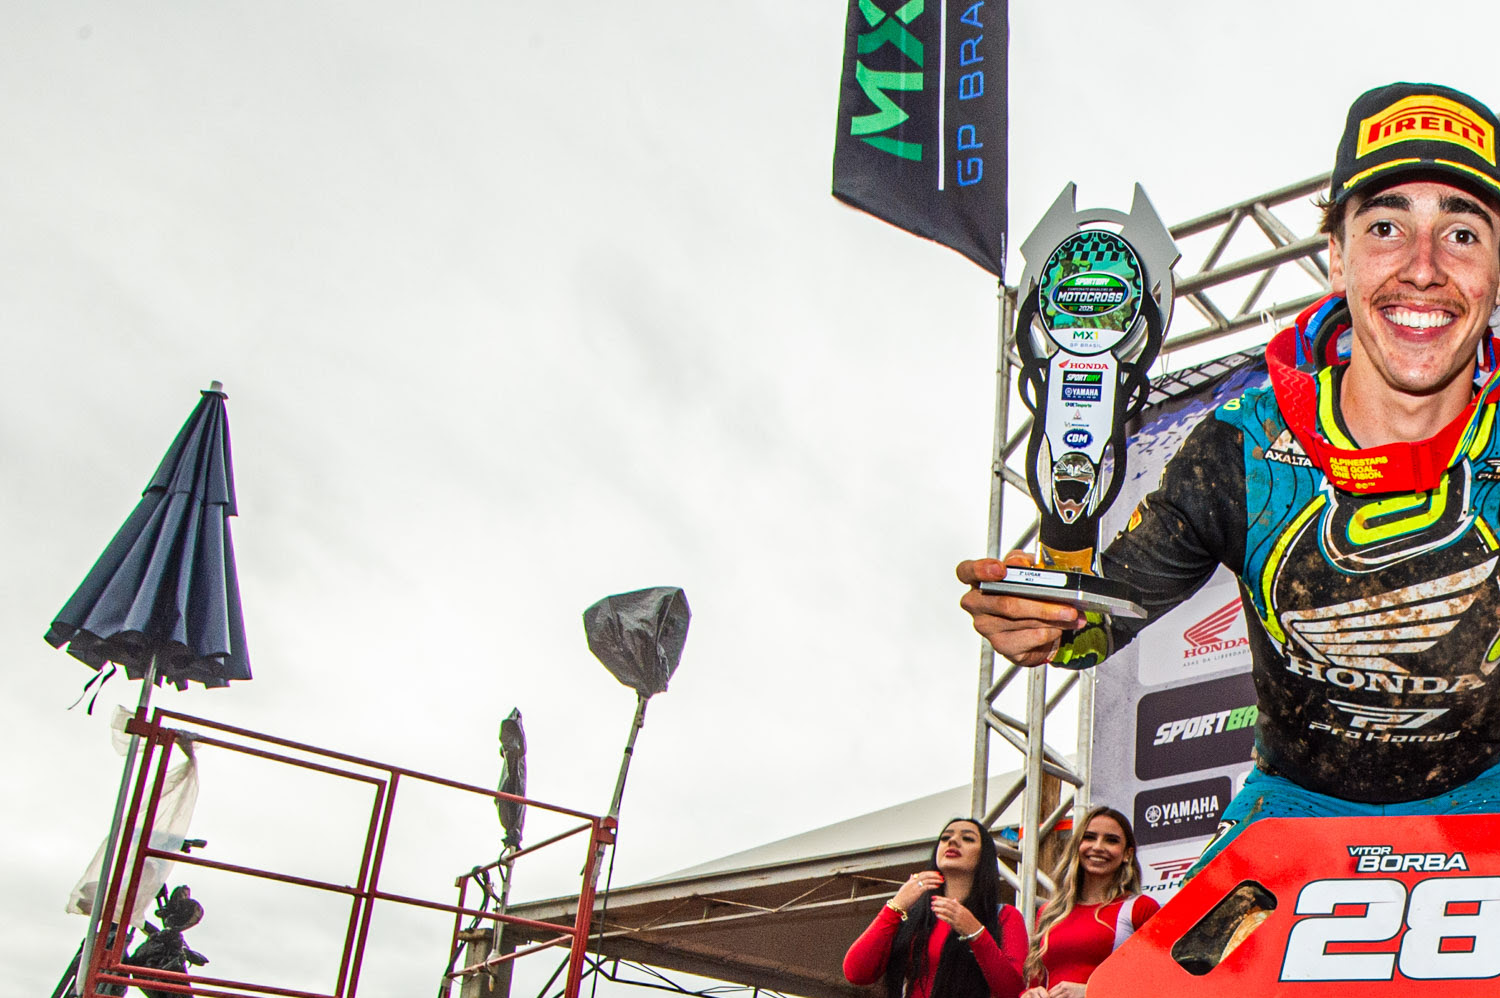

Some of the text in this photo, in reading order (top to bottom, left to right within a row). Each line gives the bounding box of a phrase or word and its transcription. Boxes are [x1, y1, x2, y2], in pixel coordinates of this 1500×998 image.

[1367, 105, 1486, 150] PIRELLI
[956, 124, 984, 187] GP
[1057, 292, 1124, 303] MOTOCROSS
[1078, 304, 1094, 312] 2025
[1073, 330, 1099, 340] MX1
[1070, 362, 1109, 370] HONDA
[1065, 373, 1101, 382] SPORTBAY
[1072, 387, 1099, 396] YAMAHA
[1066, 434, 1088, 444] CBM
[1265, 451, 1314, 467] AXALTA
[1329, 455, 1389, 468] ALPINESTARS
[1330, 463, 1378, 474] ONE GOAL.
[1332, 469, 1384, 480] ONE VISION.
[1184, 638, 1249, 659] HONDA
[1286, 652, 1487, 695] HONDA
[1153, 704, 1260, 746] SPORTBA
[1161, 795, 1219, 820] YAMAHA
[1150, 812, 1216, 828] RACING
[1349, 846, 1392, 856] VITOR
[1357, 853, 1467, 872] BORBA
